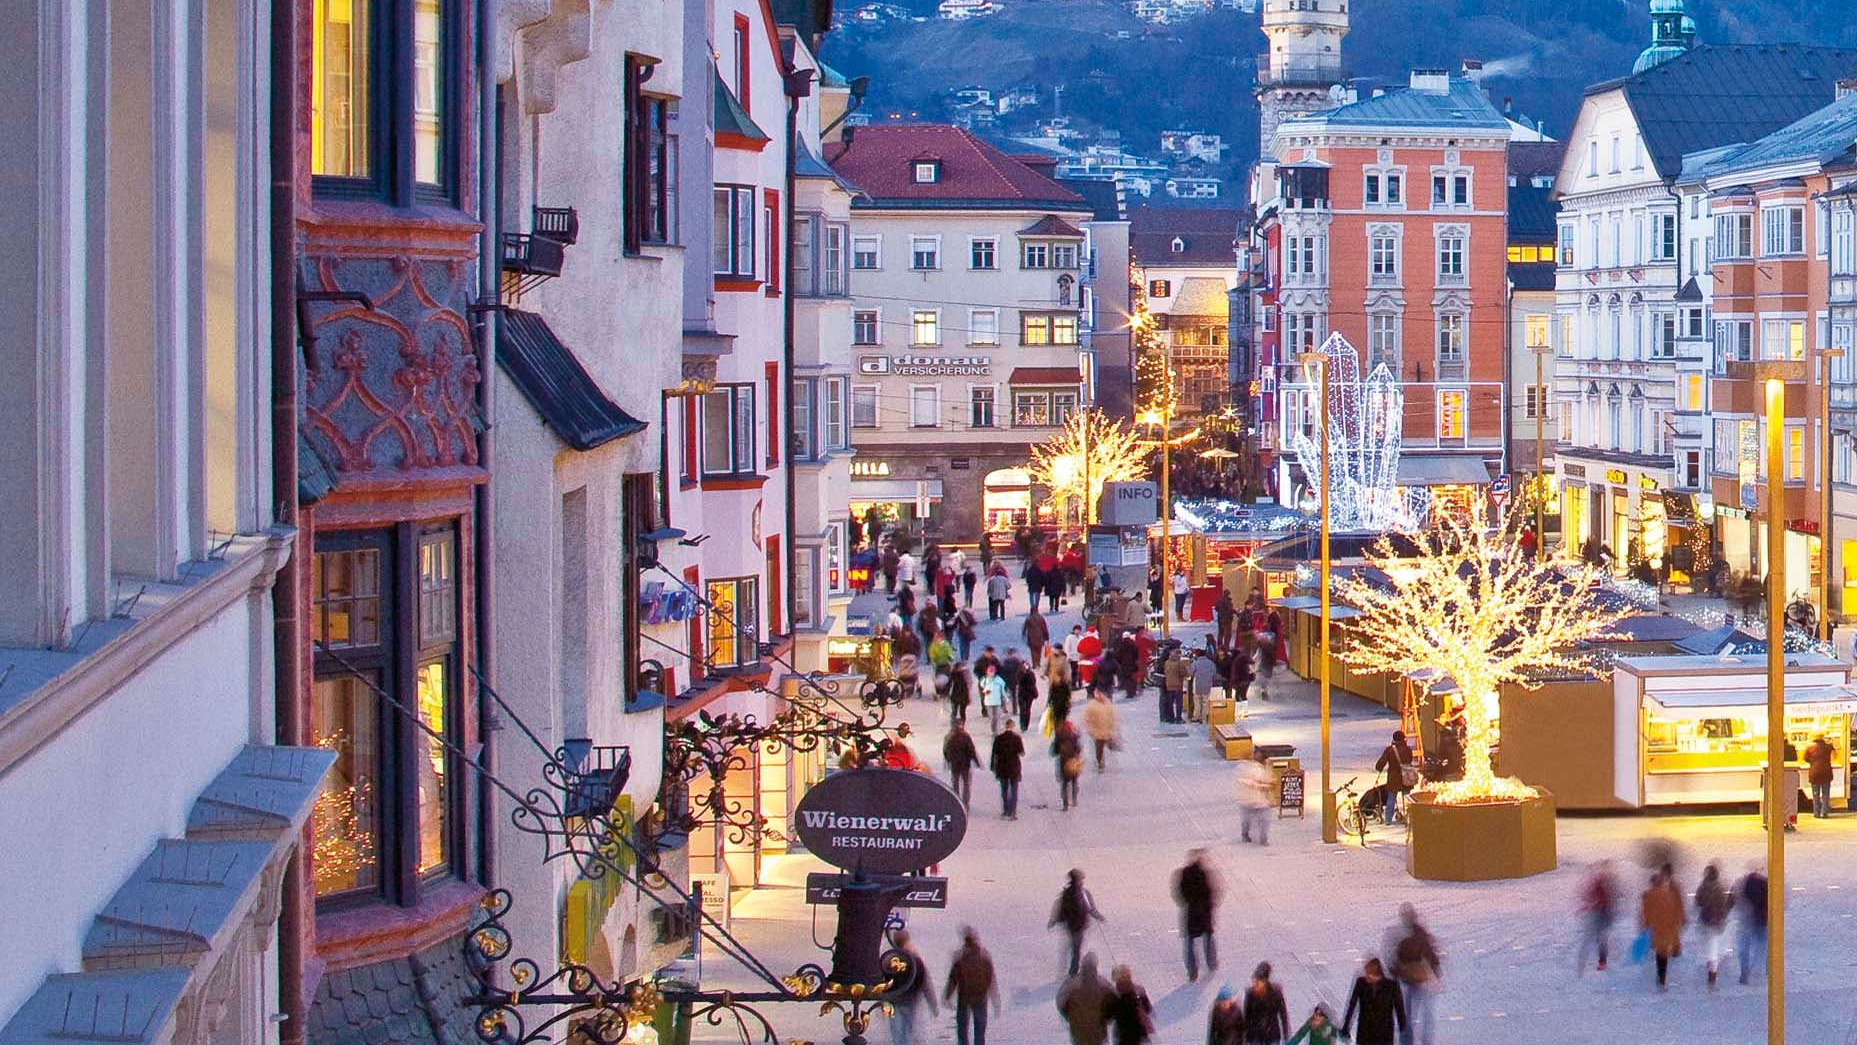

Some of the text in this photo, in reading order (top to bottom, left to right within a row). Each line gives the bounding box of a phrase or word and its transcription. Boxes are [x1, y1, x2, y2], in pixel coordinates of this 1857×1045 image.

[894, 355, 990, 365] donau
[894, 366, 990, 375] VERSICHERUNG
[1118, 488, 1153, 499] INFO
[832, 836, 923, 849] RESTAURANT
